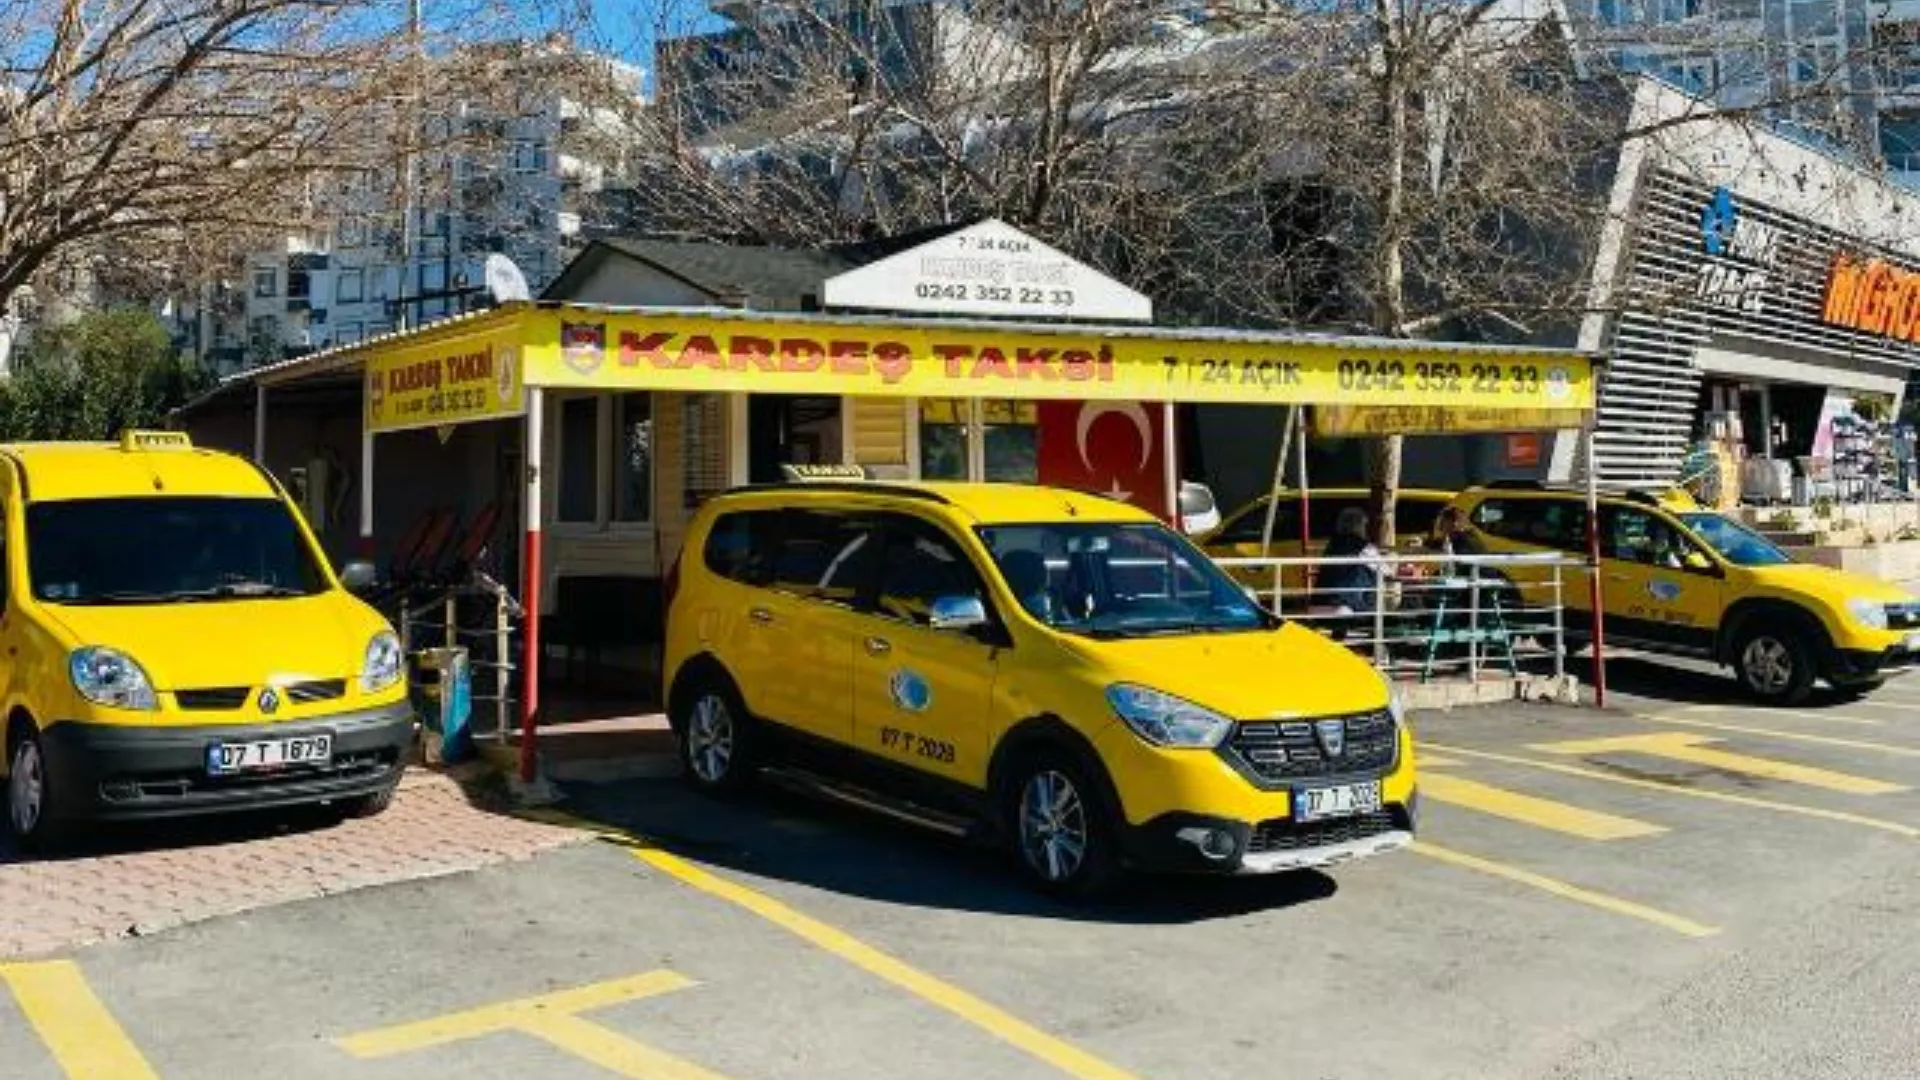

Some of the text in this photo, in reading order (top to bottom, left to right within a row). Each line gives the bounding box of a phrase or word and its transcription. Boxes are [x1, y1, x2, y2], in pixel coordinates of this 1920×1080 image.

[915, 284, 1075, 306] 0242 352 22 33
[618, 330, 1114, 384] KARDEŞ TAKSİ
[1163, 357, 1177, 381] 7
[1201, 359, 1231, 383] 24
[1239, 359, 1302, 390] AÇIK
[1337, 359, 1405, 390] 0242
[1414, 362, 1461, 392] 352
[1471, 363, 1500, 393] 22
[1511, 365, 1539, 393] 33
[221, 737, 328, 765] 07 T 1679
[904, 732, 916, 751] T
